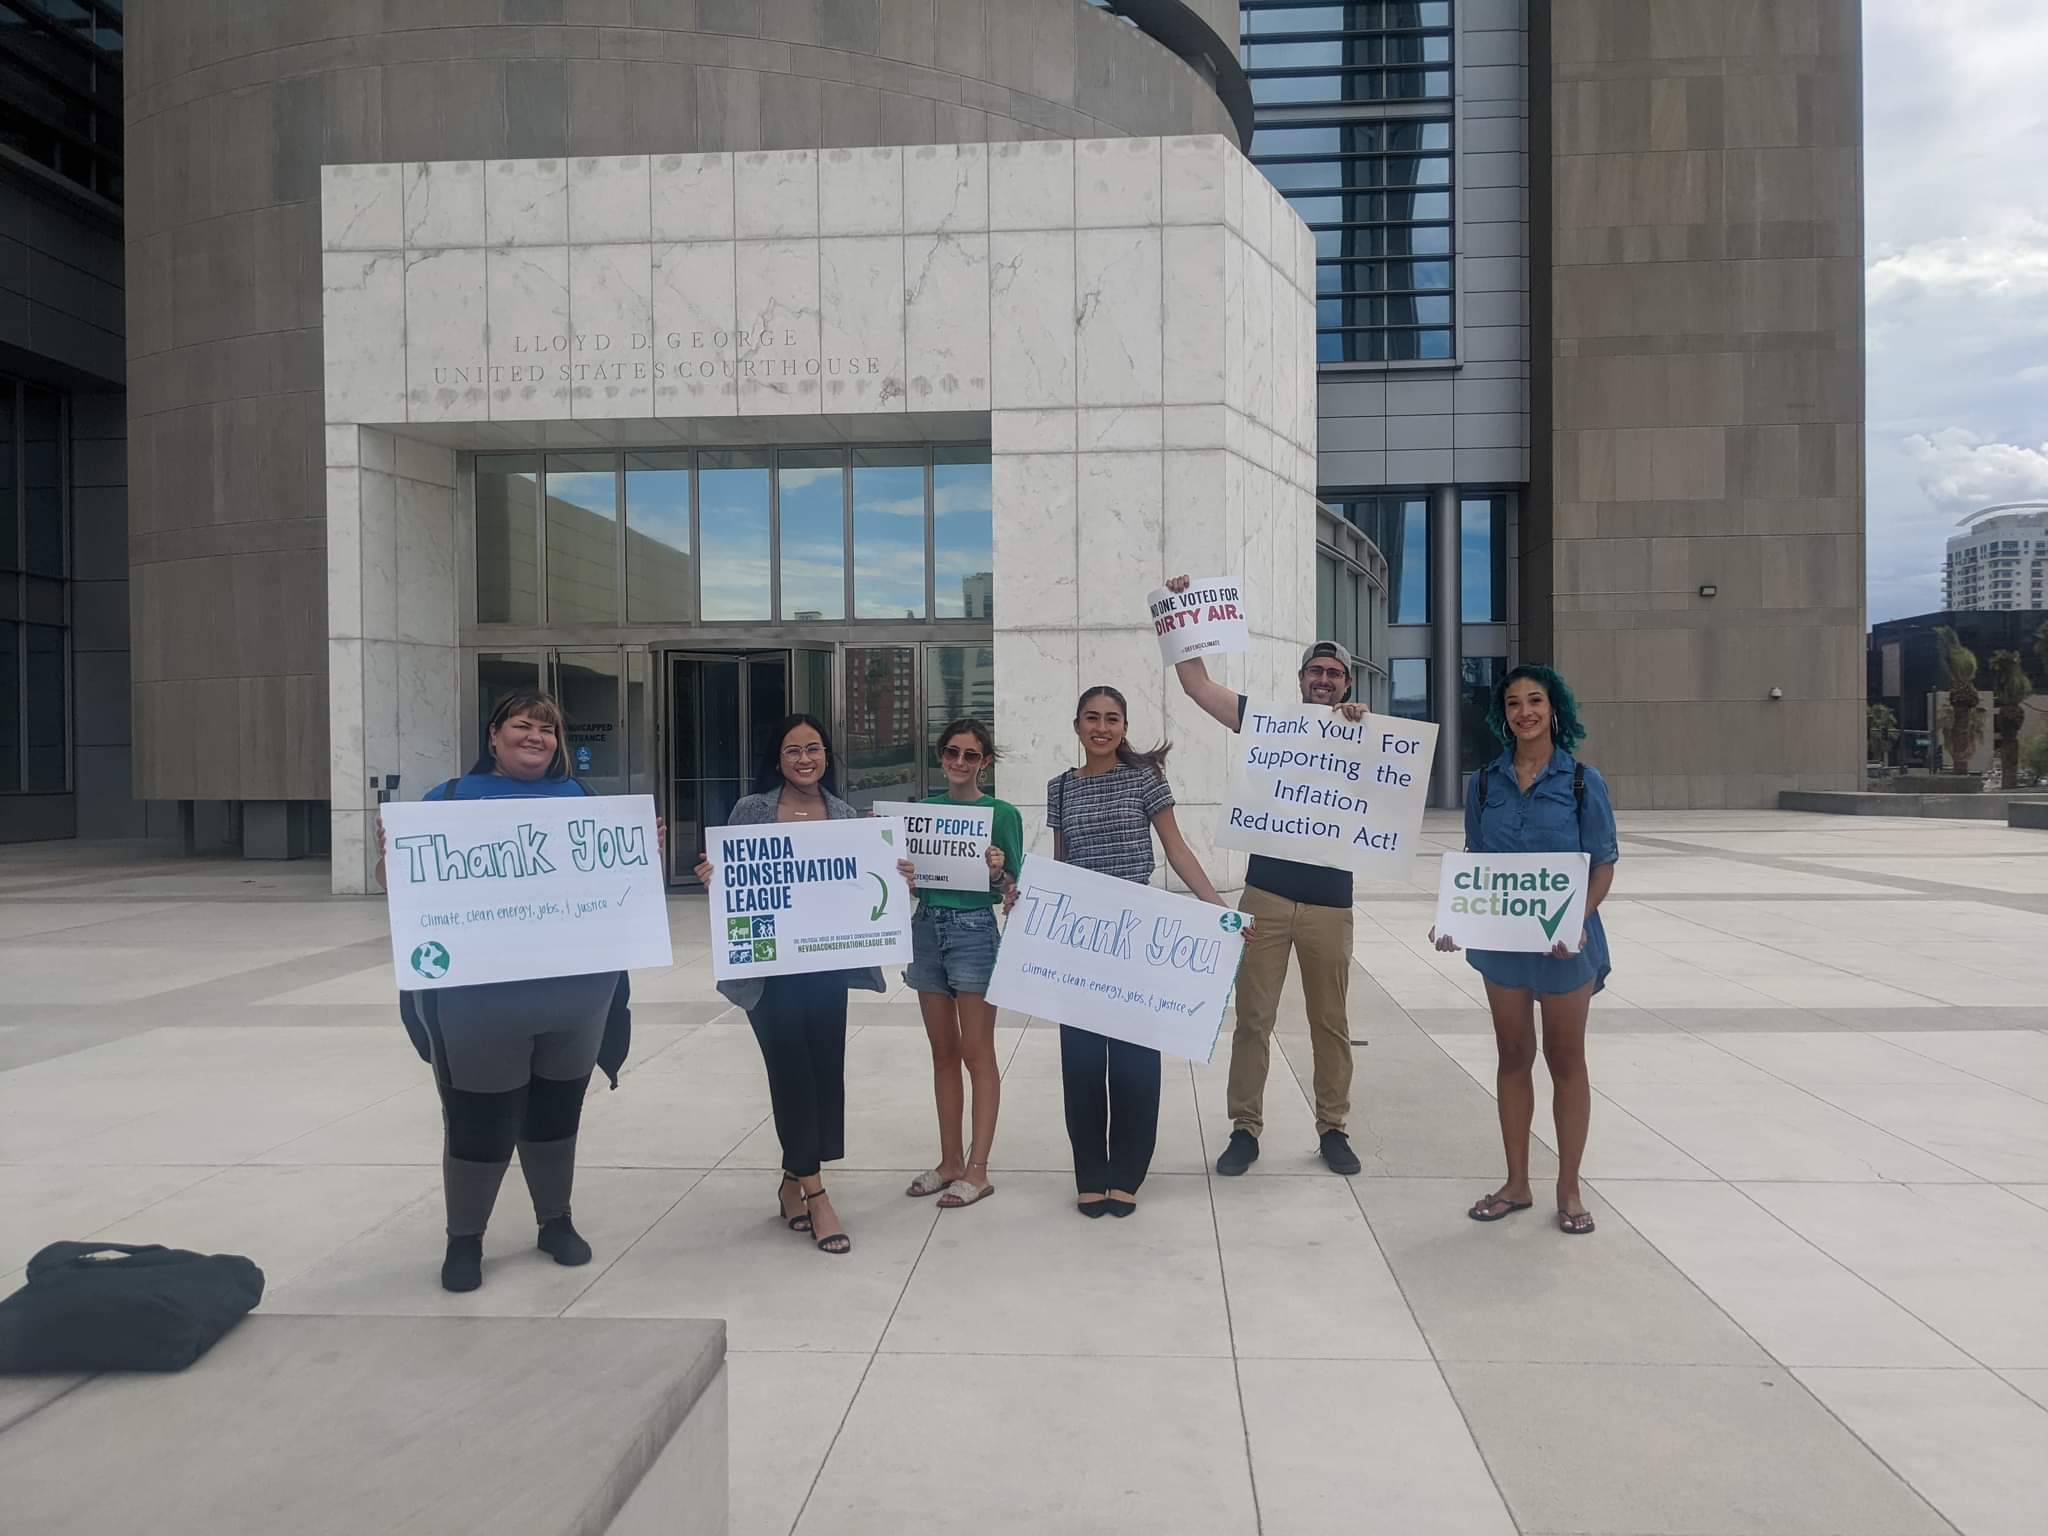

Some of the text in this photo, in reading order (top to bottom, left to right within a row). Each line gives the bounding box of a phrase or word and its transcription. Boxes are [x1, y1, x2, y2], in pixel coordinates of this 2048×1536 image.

[514, 329, 797, 353] LLOYD D. GEORGE
[433, 357, 880, 384] UNITED STATES COURTHOUSE
[1158, 597, 1177, 614] ONE
[1179, 589, 1218, 607] VOTED
[1219, 588, 1239, 602] FOR
[1155, 604, 1244, 636] DIRTY AIR.
[1252, 714, 1420, 754] Thank You! For
[1247, 746, 1412, 787] Supporting the
[1274, 779, 1368, 814] Inflation
[935, 818, 988, 838] PEOPLE.
[1229, 807, 1399, 851] Reduction Act!
[396, 819, 648, 883] Thank You
[723, 836, 795, 863] NEVADA
[724, 856, 858, 888] CONSERVATION
[1454, 866, 1570, 891] climate
[466, 908, 495, 923] clean
[574, 899, 608, 918] justice
[726, 886, 792, 913] LEAGUE
[1451, 892, 1547, 916] action
[1026, 885, 1221, 974] Thank You
[798, 937, 897, 953] NEVADACONSERVATIONLEAGUE.ORG
[1062, 973, 1087, 987] clean
[1154, 998, 1185, 1013] justice
